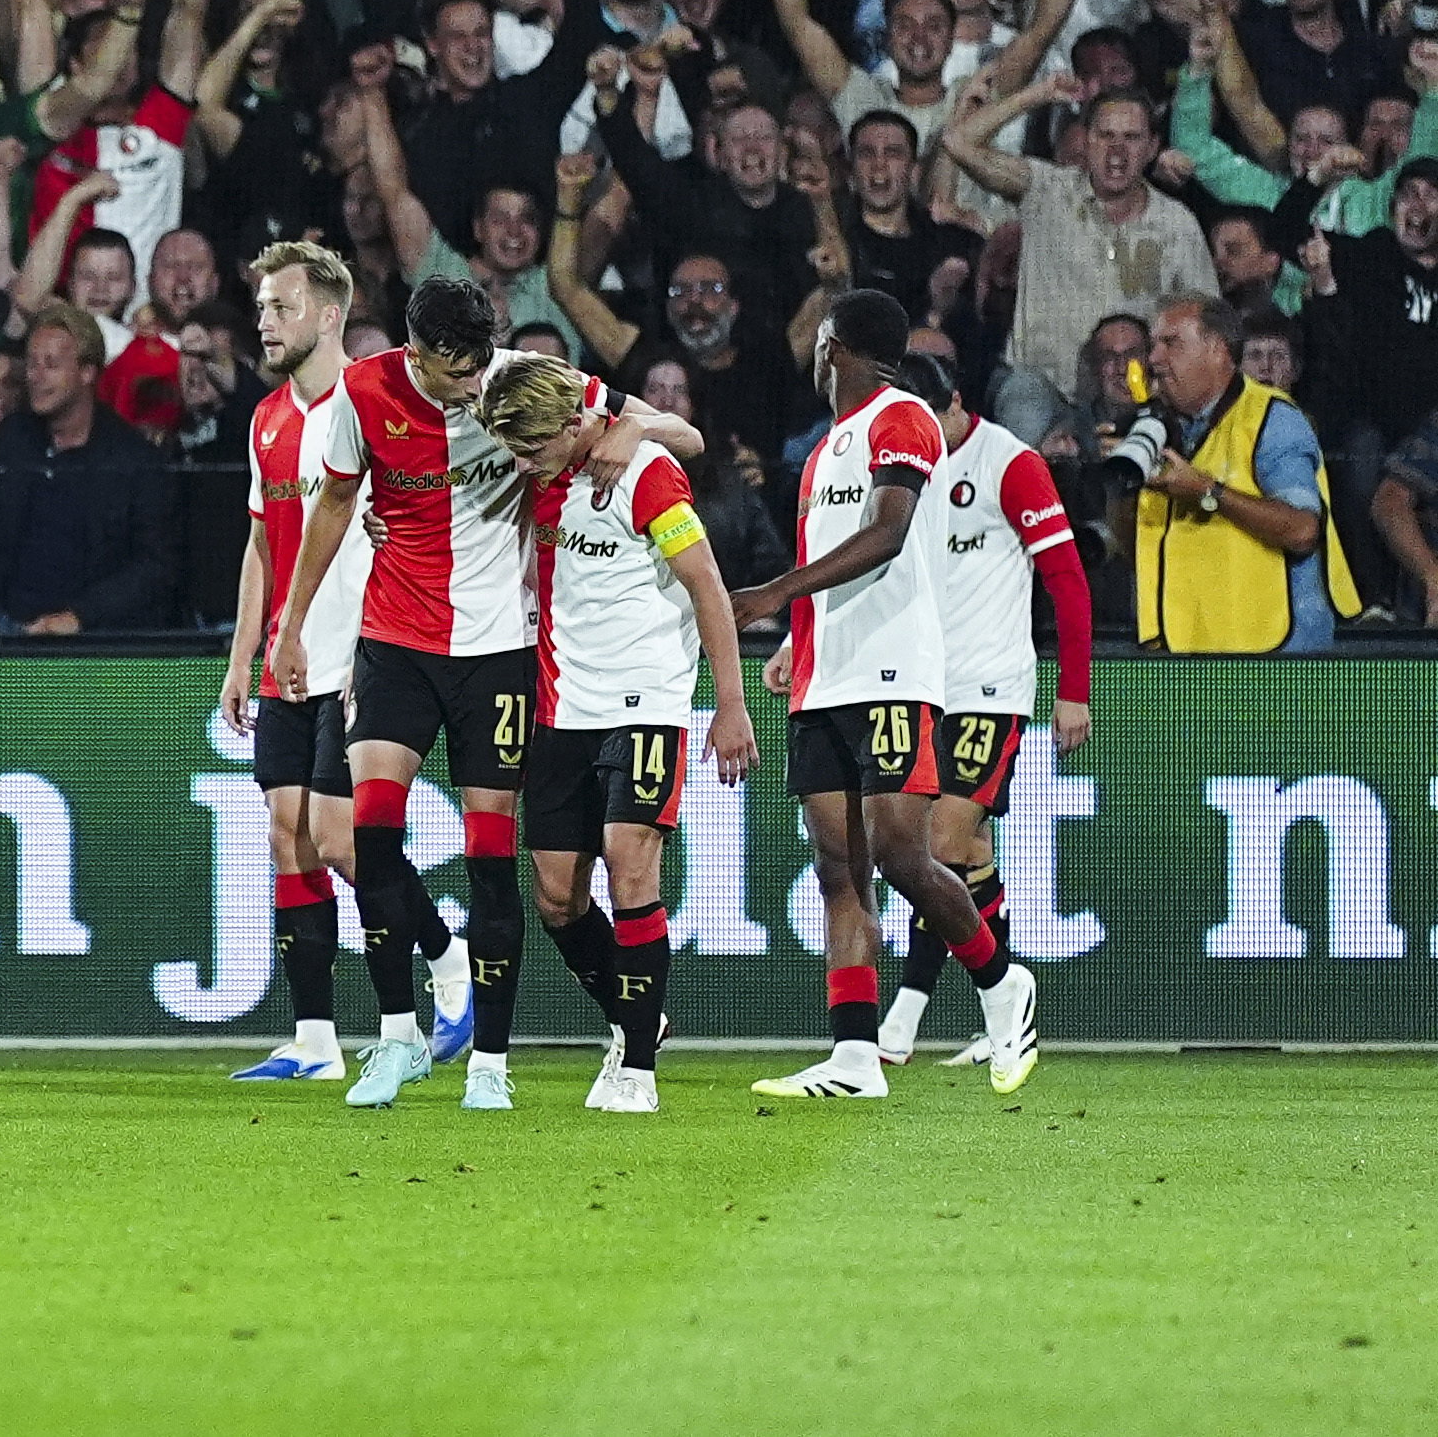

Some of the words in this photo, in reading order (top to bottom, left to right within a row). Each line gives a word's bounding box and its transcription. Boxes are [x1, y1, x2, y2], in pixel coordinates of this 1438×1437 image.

[385, 468, 446, 491] Media
[466, 458, 516, 485] Mar
[814, 485, 864, 507] Markt
[563, 531, 619, 557] Markt
[493, 694, 525, 746] 21
[868, 705, 912, 755] 26
[953, 715, 997, 765] 23
[630, 732, 666, 783] 14
[1202, 773, 1438, 959] n
